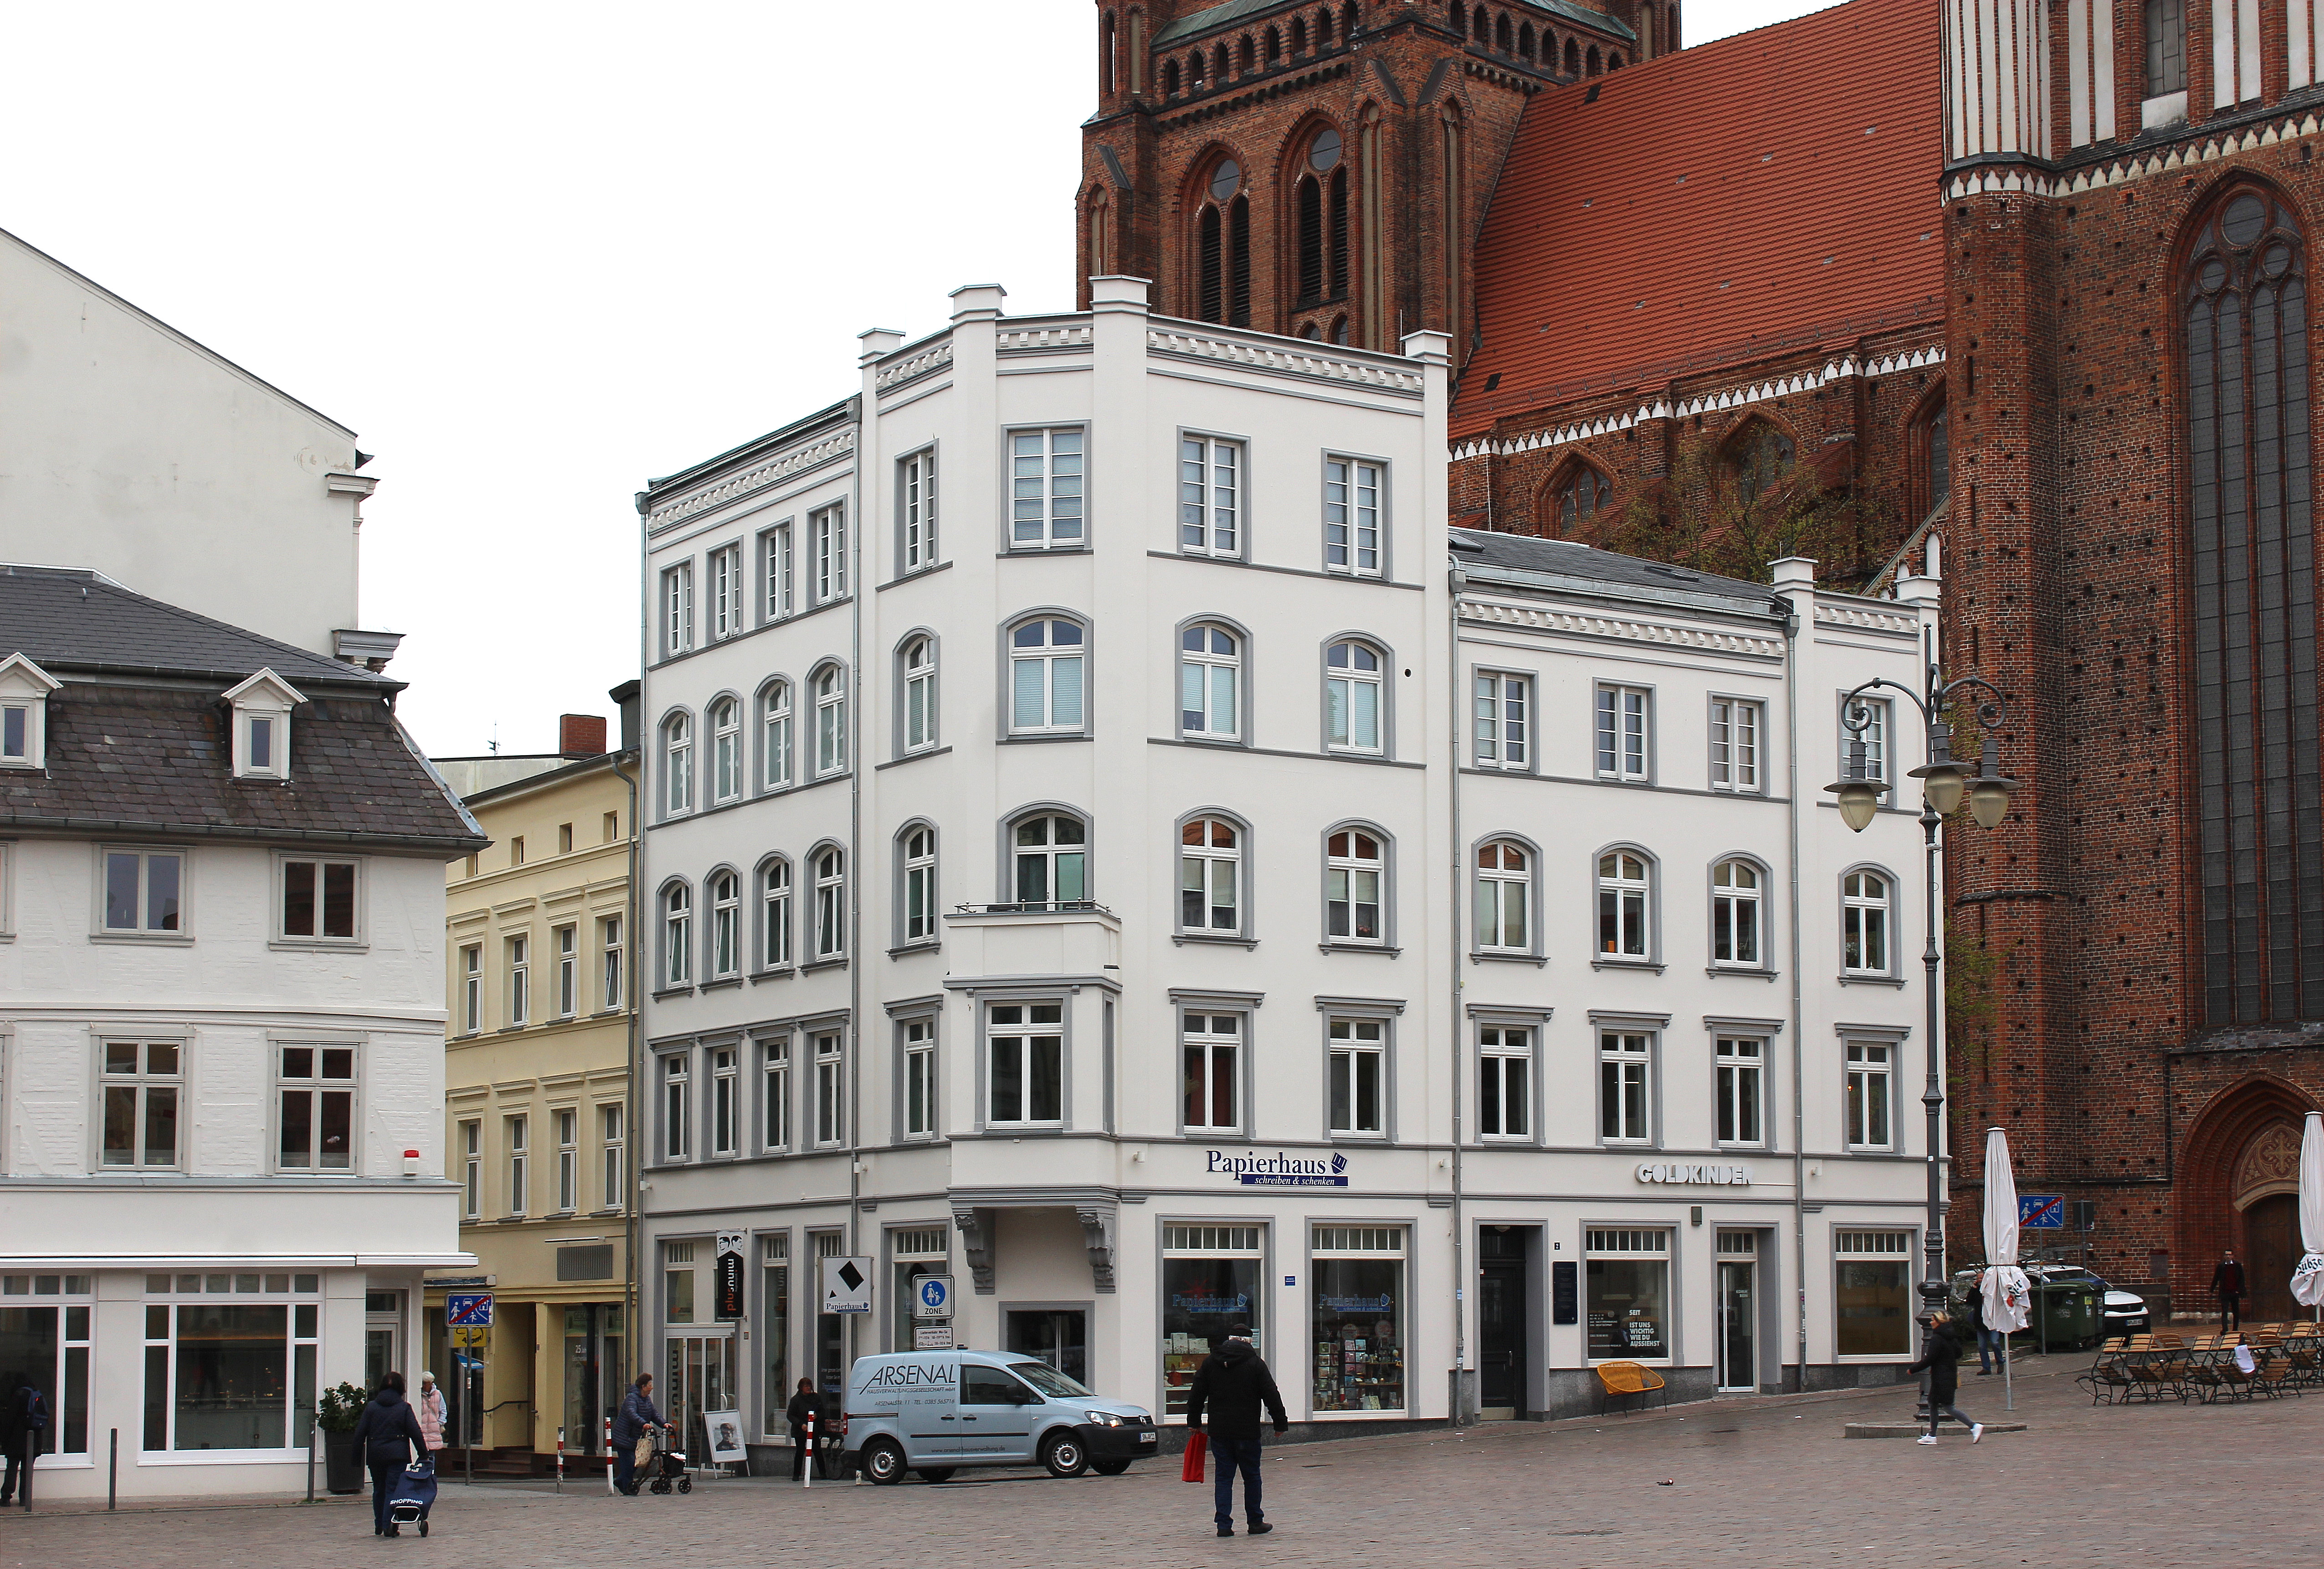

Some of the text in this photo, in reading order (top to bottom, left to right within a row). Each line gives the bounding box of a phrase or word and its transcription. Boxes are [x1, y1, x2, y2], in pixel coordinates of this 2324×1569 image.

[1206, 1150, 1326, 1180] Papierhaus
[1255, 1175, 1335, 1185] schreiben & schenken
[1636, 1164, 1753, 1185] GOLDKINDER
[826, 1301, 863, 1311] Papierhaus
[1172, 1294, 1235, 1311] Papierhaus
[1319, 1294, 1379, 1310] Papierhaus
[462, 1335, 482, 1344] Aom
[859, 1364, 956, 1395] ARSENAL
